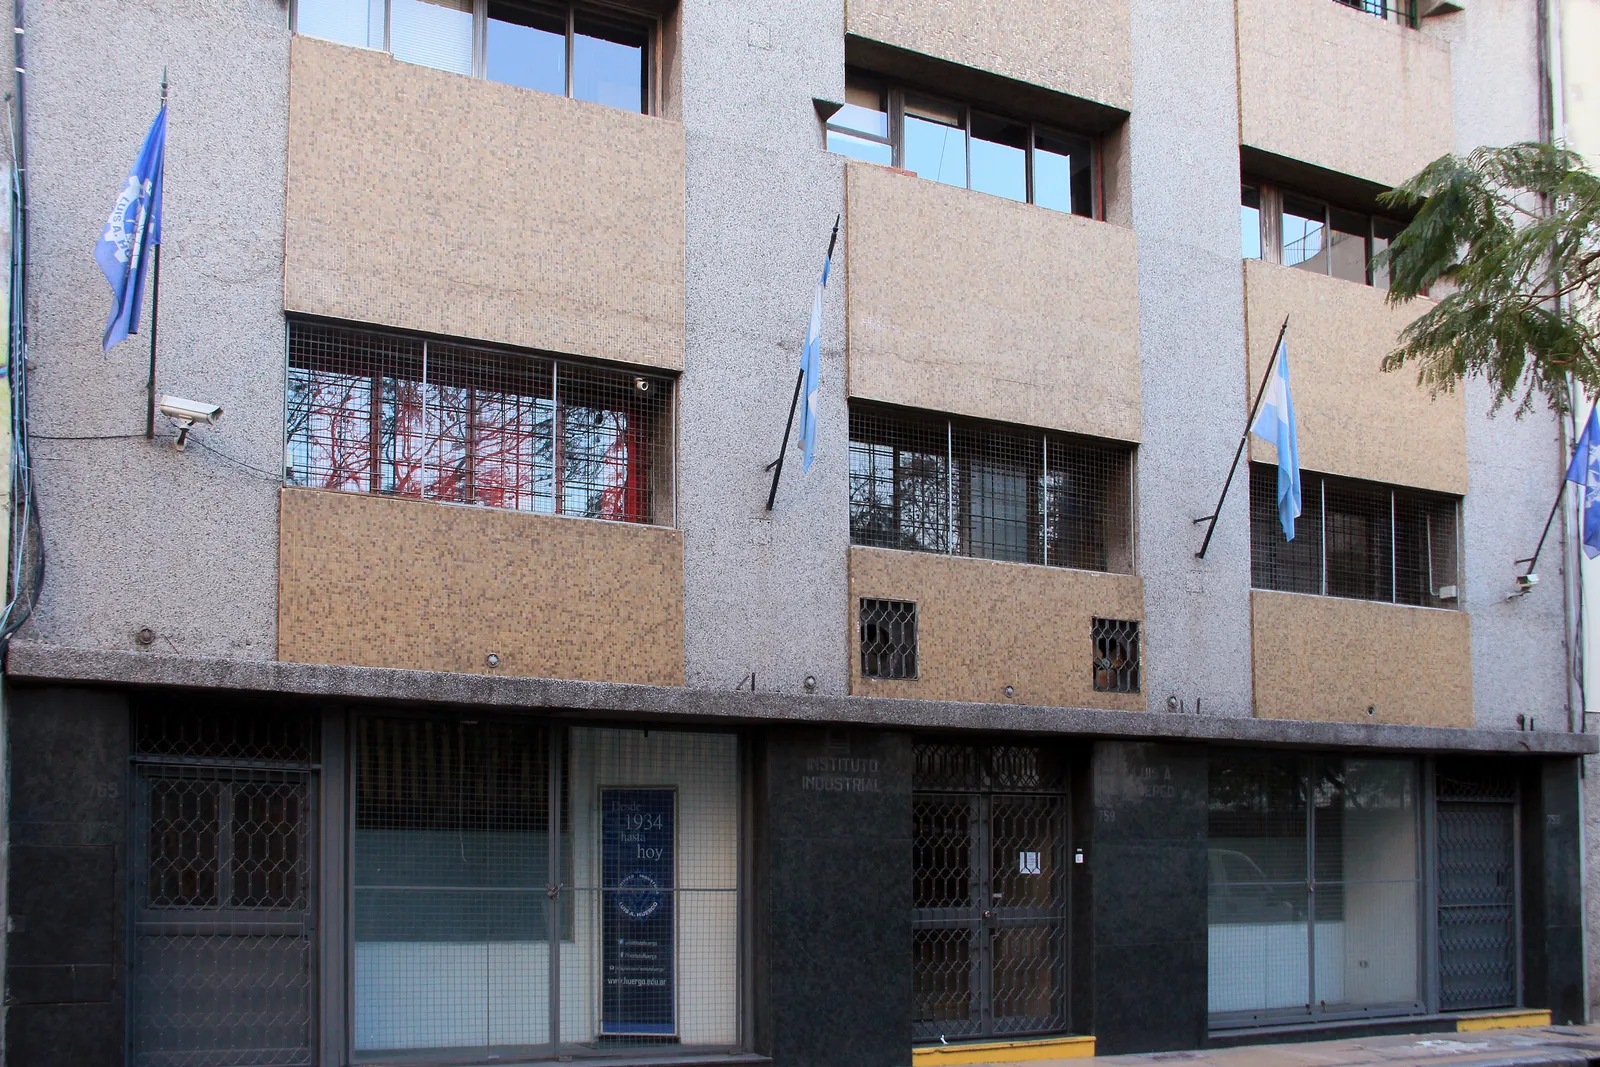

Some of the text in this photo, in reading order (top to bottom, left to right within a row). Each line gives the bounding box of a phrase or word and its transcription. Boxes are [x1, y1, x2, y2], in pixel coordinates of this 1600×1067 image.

[112, 196, 130, 223] LUIS
[807, 757, 878, 772] INSTITUTO
[801, 775, 881, 792] INDUSTRIAL
[626, 813, 663, 831] 1934
[620, 830, 646, 842] hasta
[636, 843, 664, 862] hoy
[636, 901, 659, 917] HUERGO
